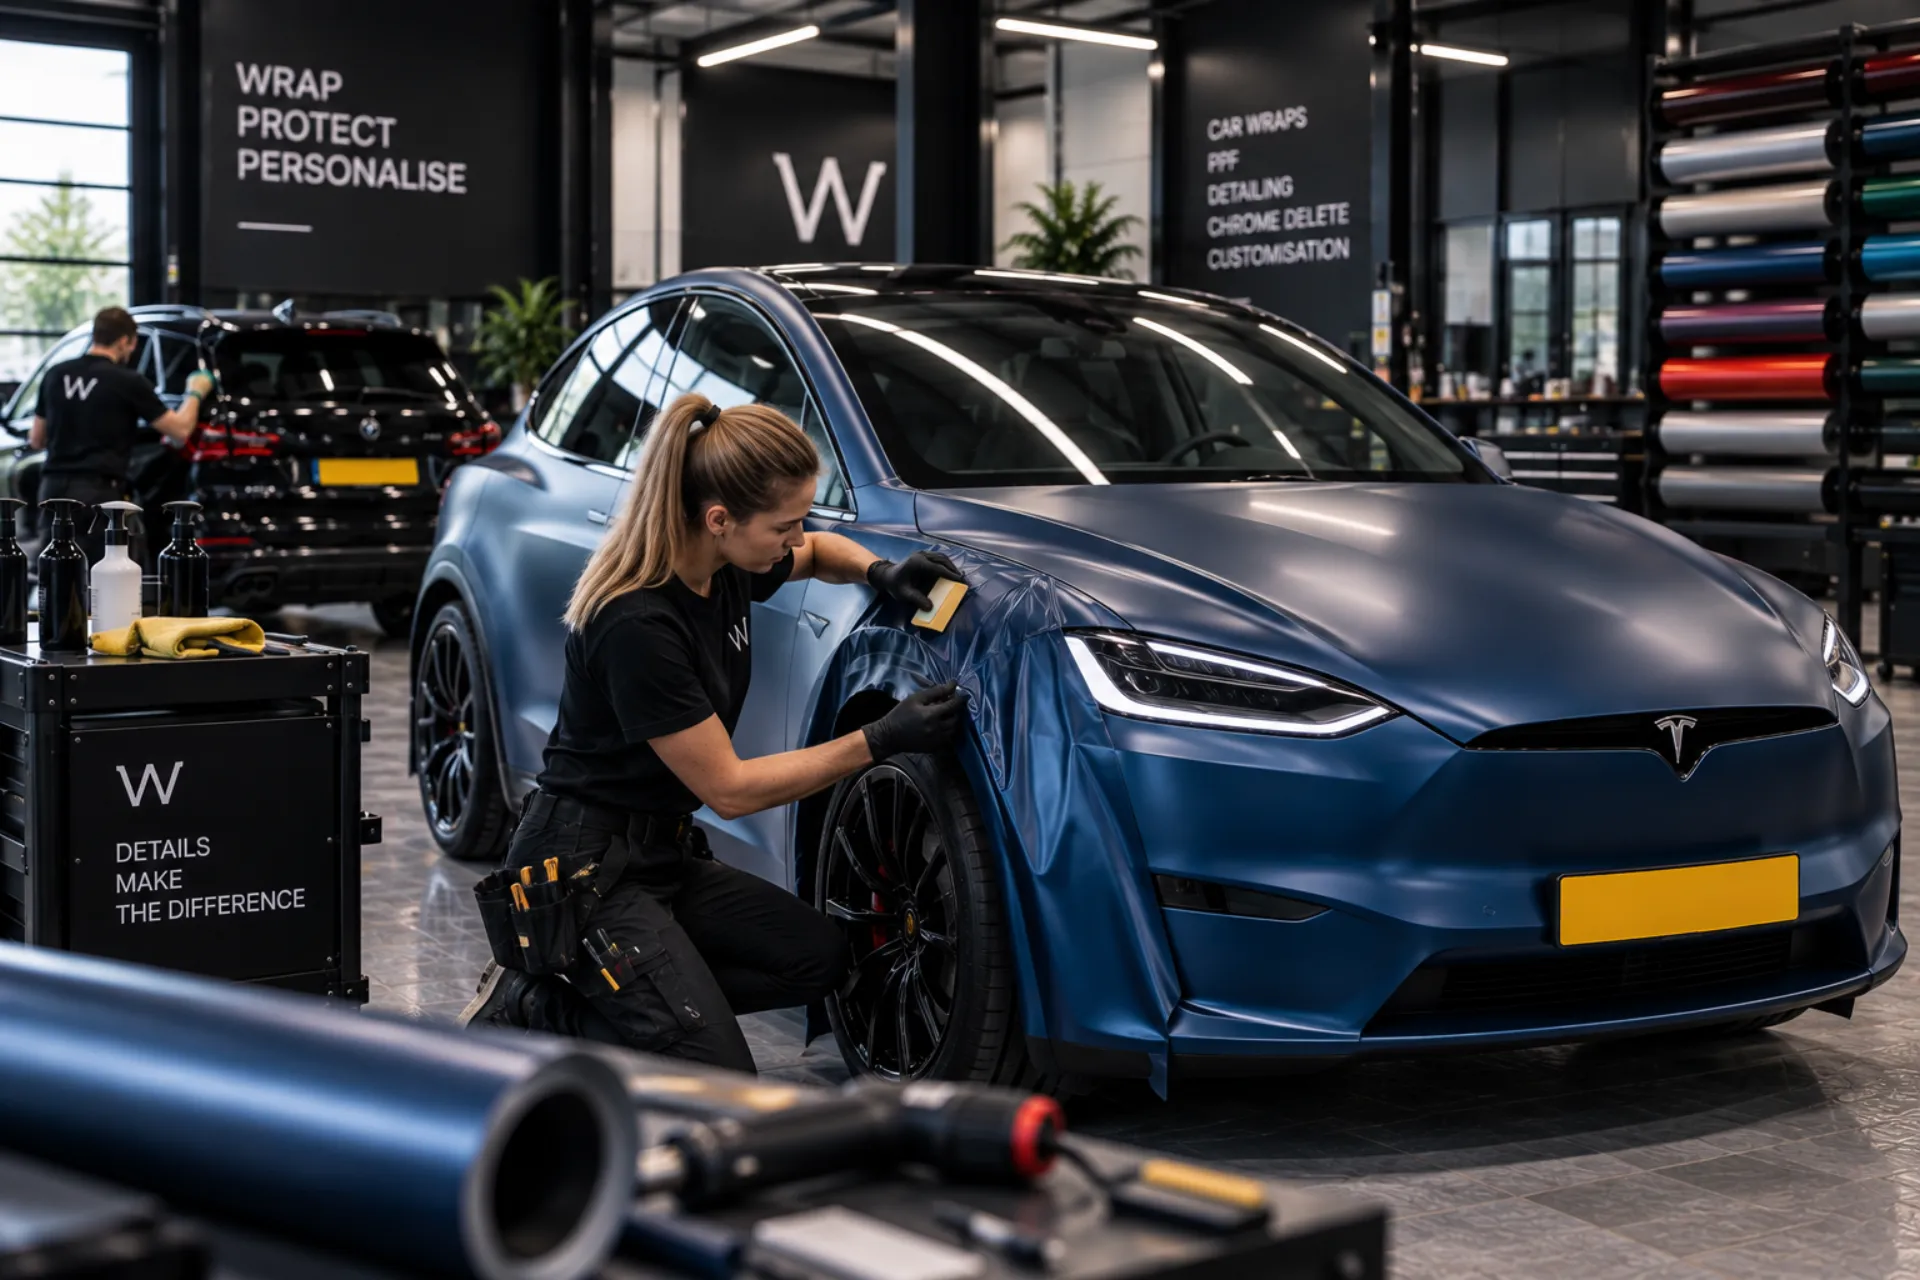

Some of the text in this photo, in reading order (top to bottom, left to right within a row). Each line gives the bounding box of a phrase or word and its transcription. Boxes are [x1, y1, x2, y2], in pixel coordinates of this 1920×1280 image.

[236, 61, 343, 101] WRAP
[238, 105, 397, 148] PROTECT
[1207, 105, 1308, 141] CAR WRAPS
[238, 148, 467, 194] PERSONALISE
[1207, 149, 1240, 174] PPF
[772, 152, 887, 246] W
[1207, 175, 1294, 206] DETAILING
[1207, 202, 1350, 238] CHROME DELETE
[1207, 237, 1350, 270] CUSTOMISATION
[63, 374, 98, 400] W
[727, 616, 749, 651] W
[116, 761, 184, 807] W
[116, 836, 211, 863] DETAILS
[116, 869, 183, 894] MAKE
[115, 888, 305, 924] THE DIFFERENCE
